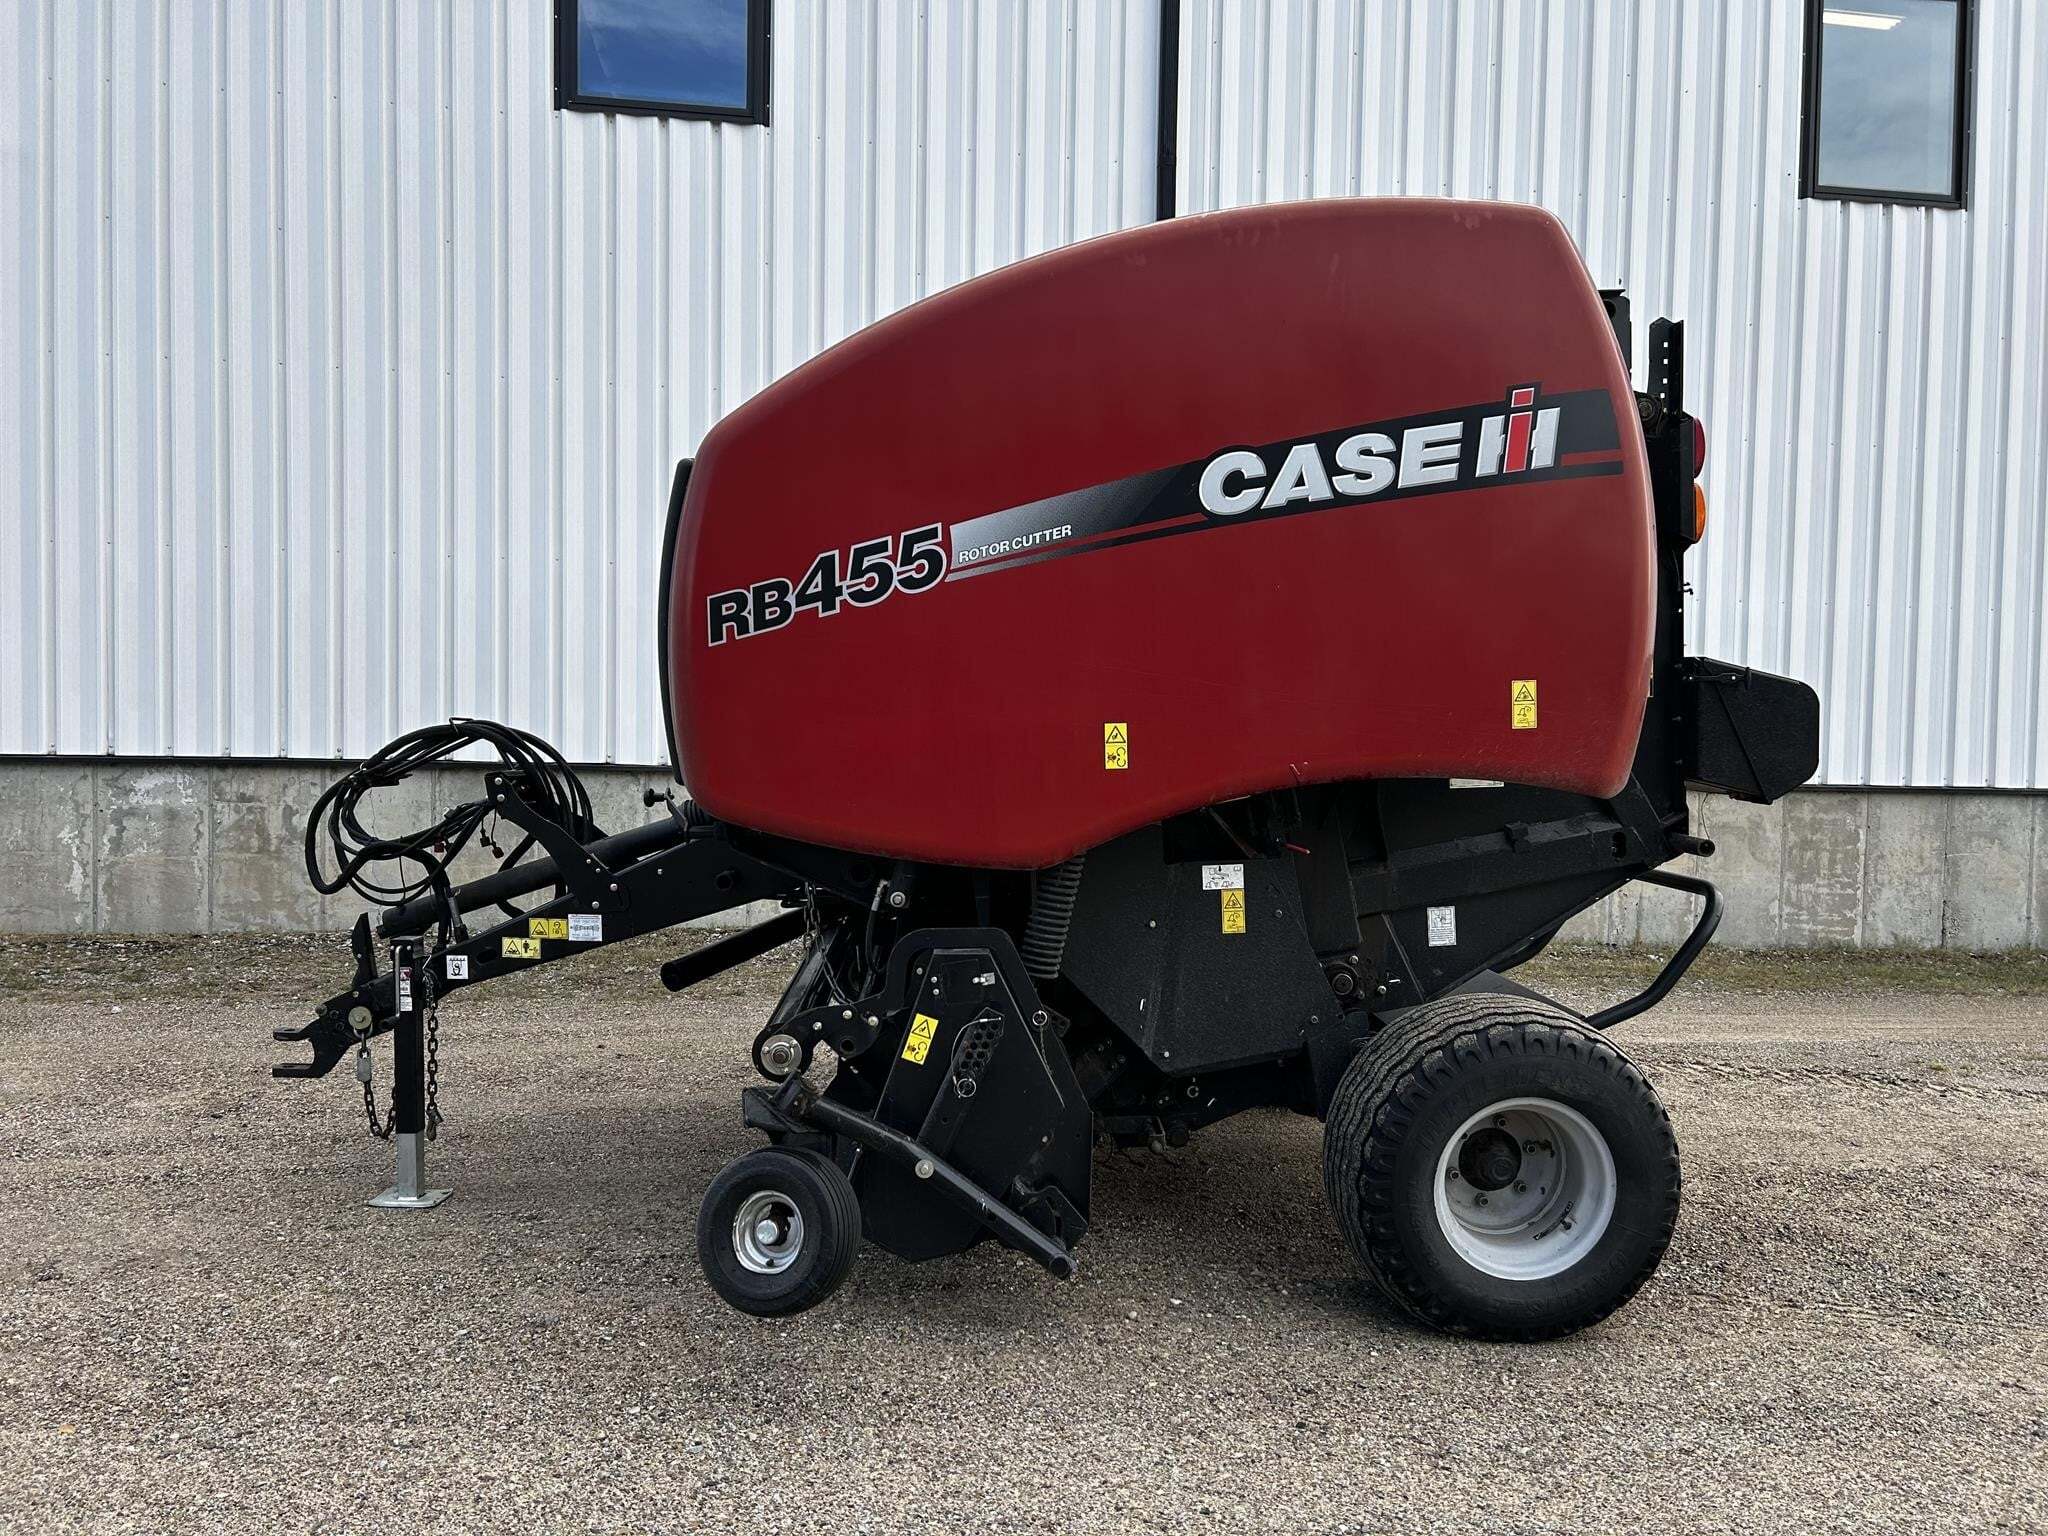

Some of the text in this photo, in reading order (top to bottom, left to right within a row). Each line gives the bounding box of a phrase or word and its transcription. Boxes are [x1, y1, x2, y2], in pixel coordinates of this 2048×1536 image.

[1198, 421, 1464, 516] CASE
[707, 522, 948, 647] RB455
[958, 524, 1072, 564] ROTOR CUTTER
